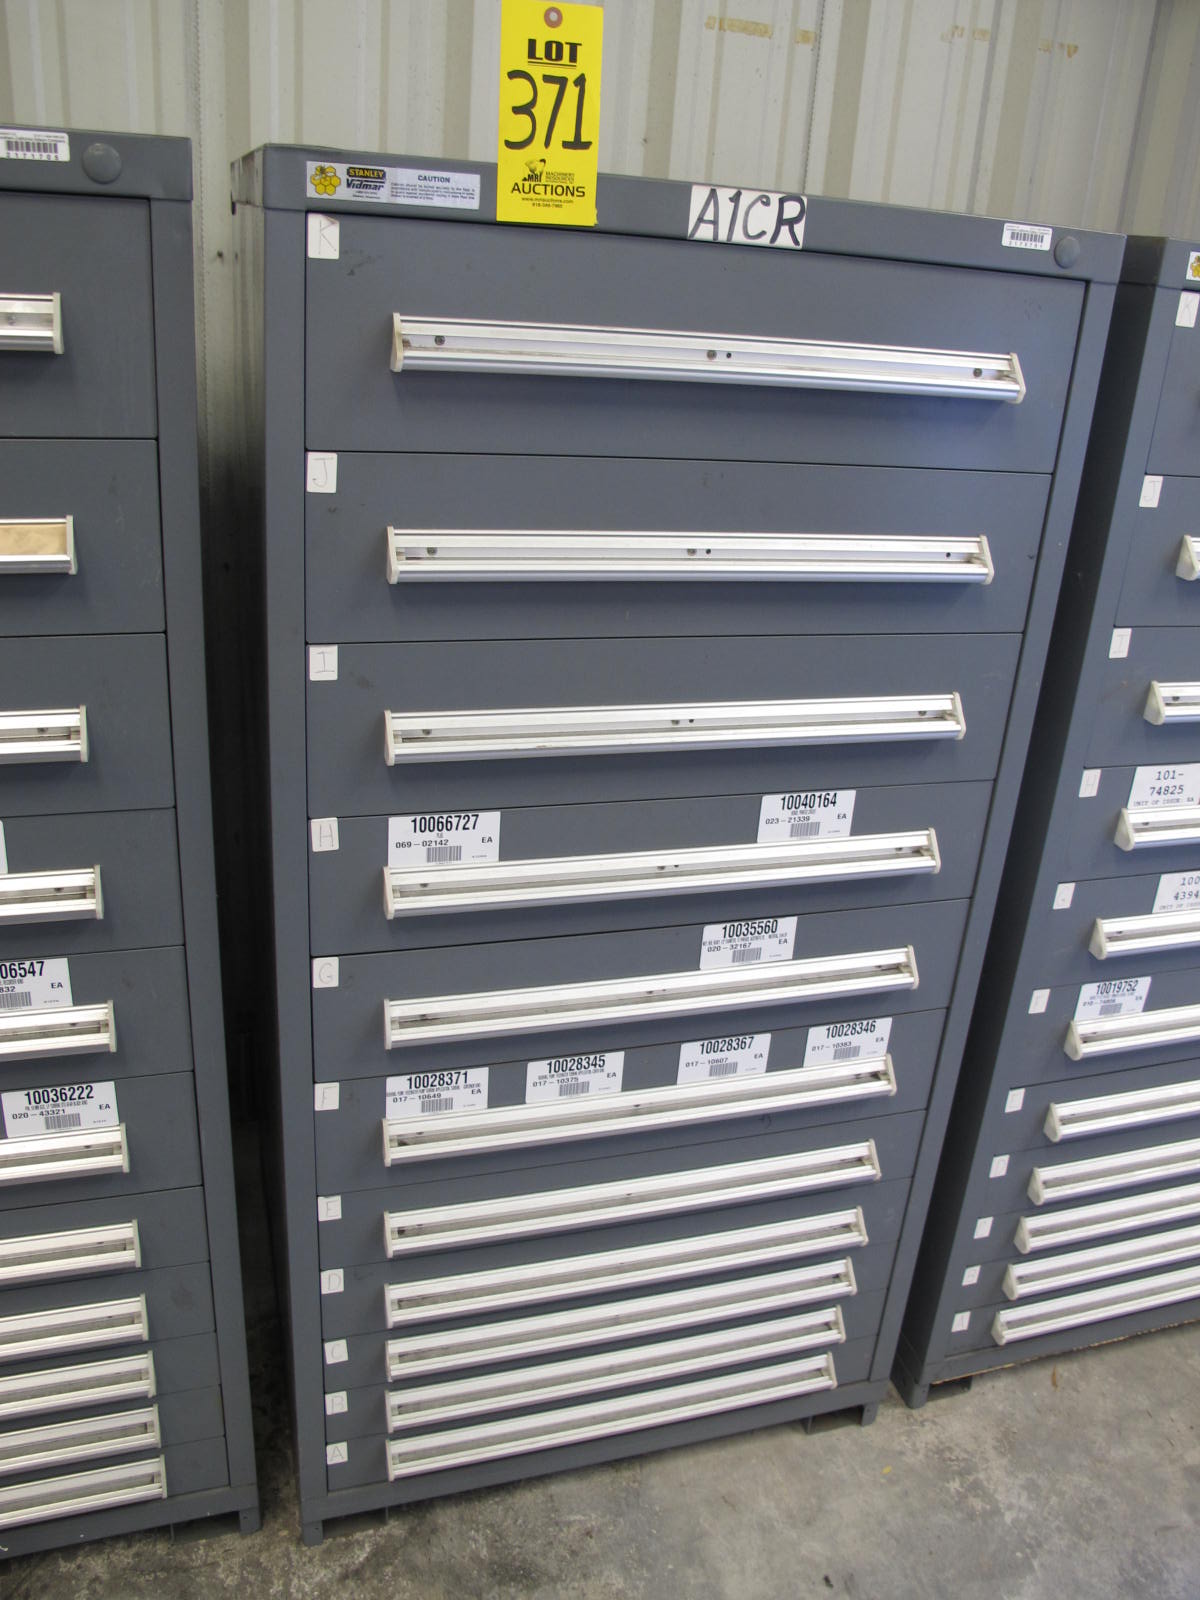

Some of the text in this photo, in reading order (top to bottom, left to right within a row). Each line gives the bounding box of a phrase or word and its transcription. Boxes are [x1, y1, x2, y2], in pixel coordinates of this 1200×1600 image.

[527, 38, 582, 63] LOT
[504, 69, 592, 150] 371
[349, 168, 384, 178] STANLEY
[417, 175, 451, 183] CAUTION
[346, 178, 384, 190] Vidmar
[511, 182, 586, 198] AUCTIONS
[689, 187, 806, 246] A1CR
[318, 219, 337, 255] K
[312, 457, 335, 488] J
[314, 650, 336, 673] I
[1155, 769, 1184, 780] 101-
[1150, 784, 1184, 796] 74825
[781, 792, 838, 810] 10040164
[411, 814, 479, 833] 10066727
[318, 823, 335, 848] H
[481, 836, 493, 844] EA
[722, 919, 778, 938] 10035560
[0, 960, 44, 979] 06547
[318, 962, 334, 985] G
[1096, 979, 1139, 995] 10019752
[825, 1020, 877, 1039] 10028346
[699, 1036, 755, 1055] 10028367
[546, 1055, 606, 1074] 10028345
[407, 1071, 468, 1090] 10028371
[25, 1084, 94, 1105] 10036222
[325, 1199, 341, 1218] E
[327, 1272, 341, 1292] D
[329, 1445, 345, 1462] A
